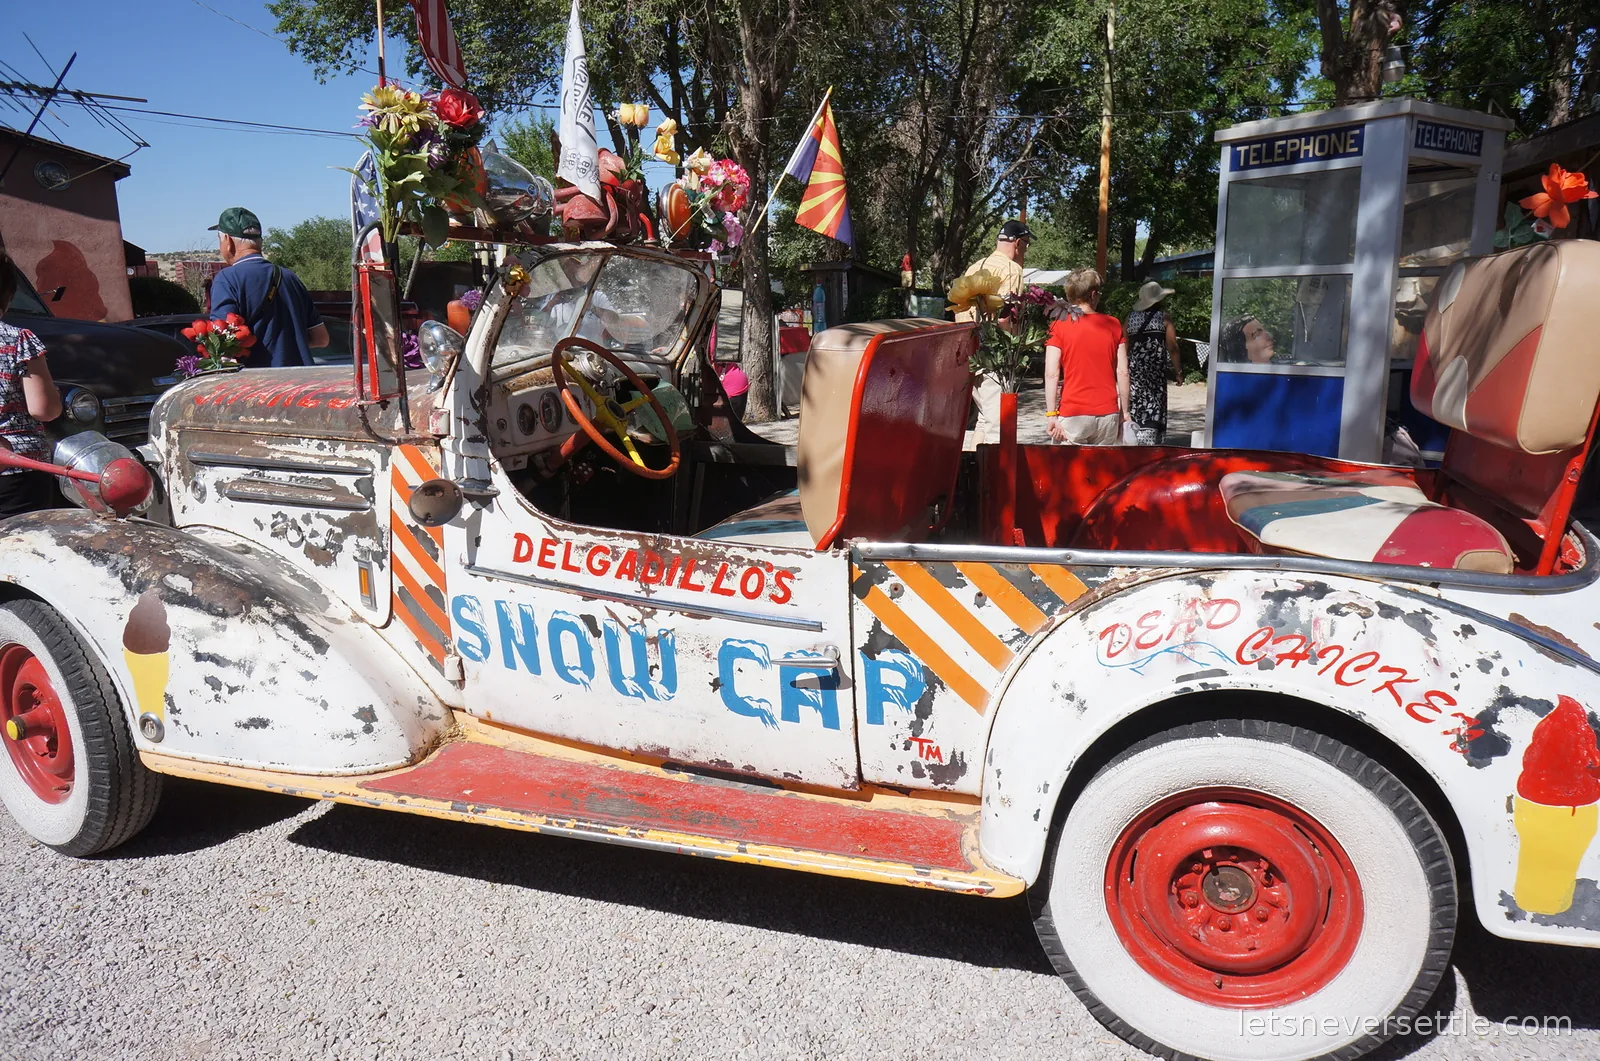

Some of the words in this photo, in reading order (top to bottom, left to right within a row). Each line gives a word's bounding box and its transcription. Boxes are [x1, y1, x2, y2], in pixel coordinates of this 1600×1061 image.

[1236, 129, 1360, 167] TELEPHONE
[1417, 123, 1480, 153] TELEPHONE
[512, 532, 795, 604] DELGADILLO'S
[1099, 597, 1241, 659] DEAD
[451, 594, 678, 703] SNOW
[717, 637, 927, 731] CAP
[908, 736, 943, 763] TM
